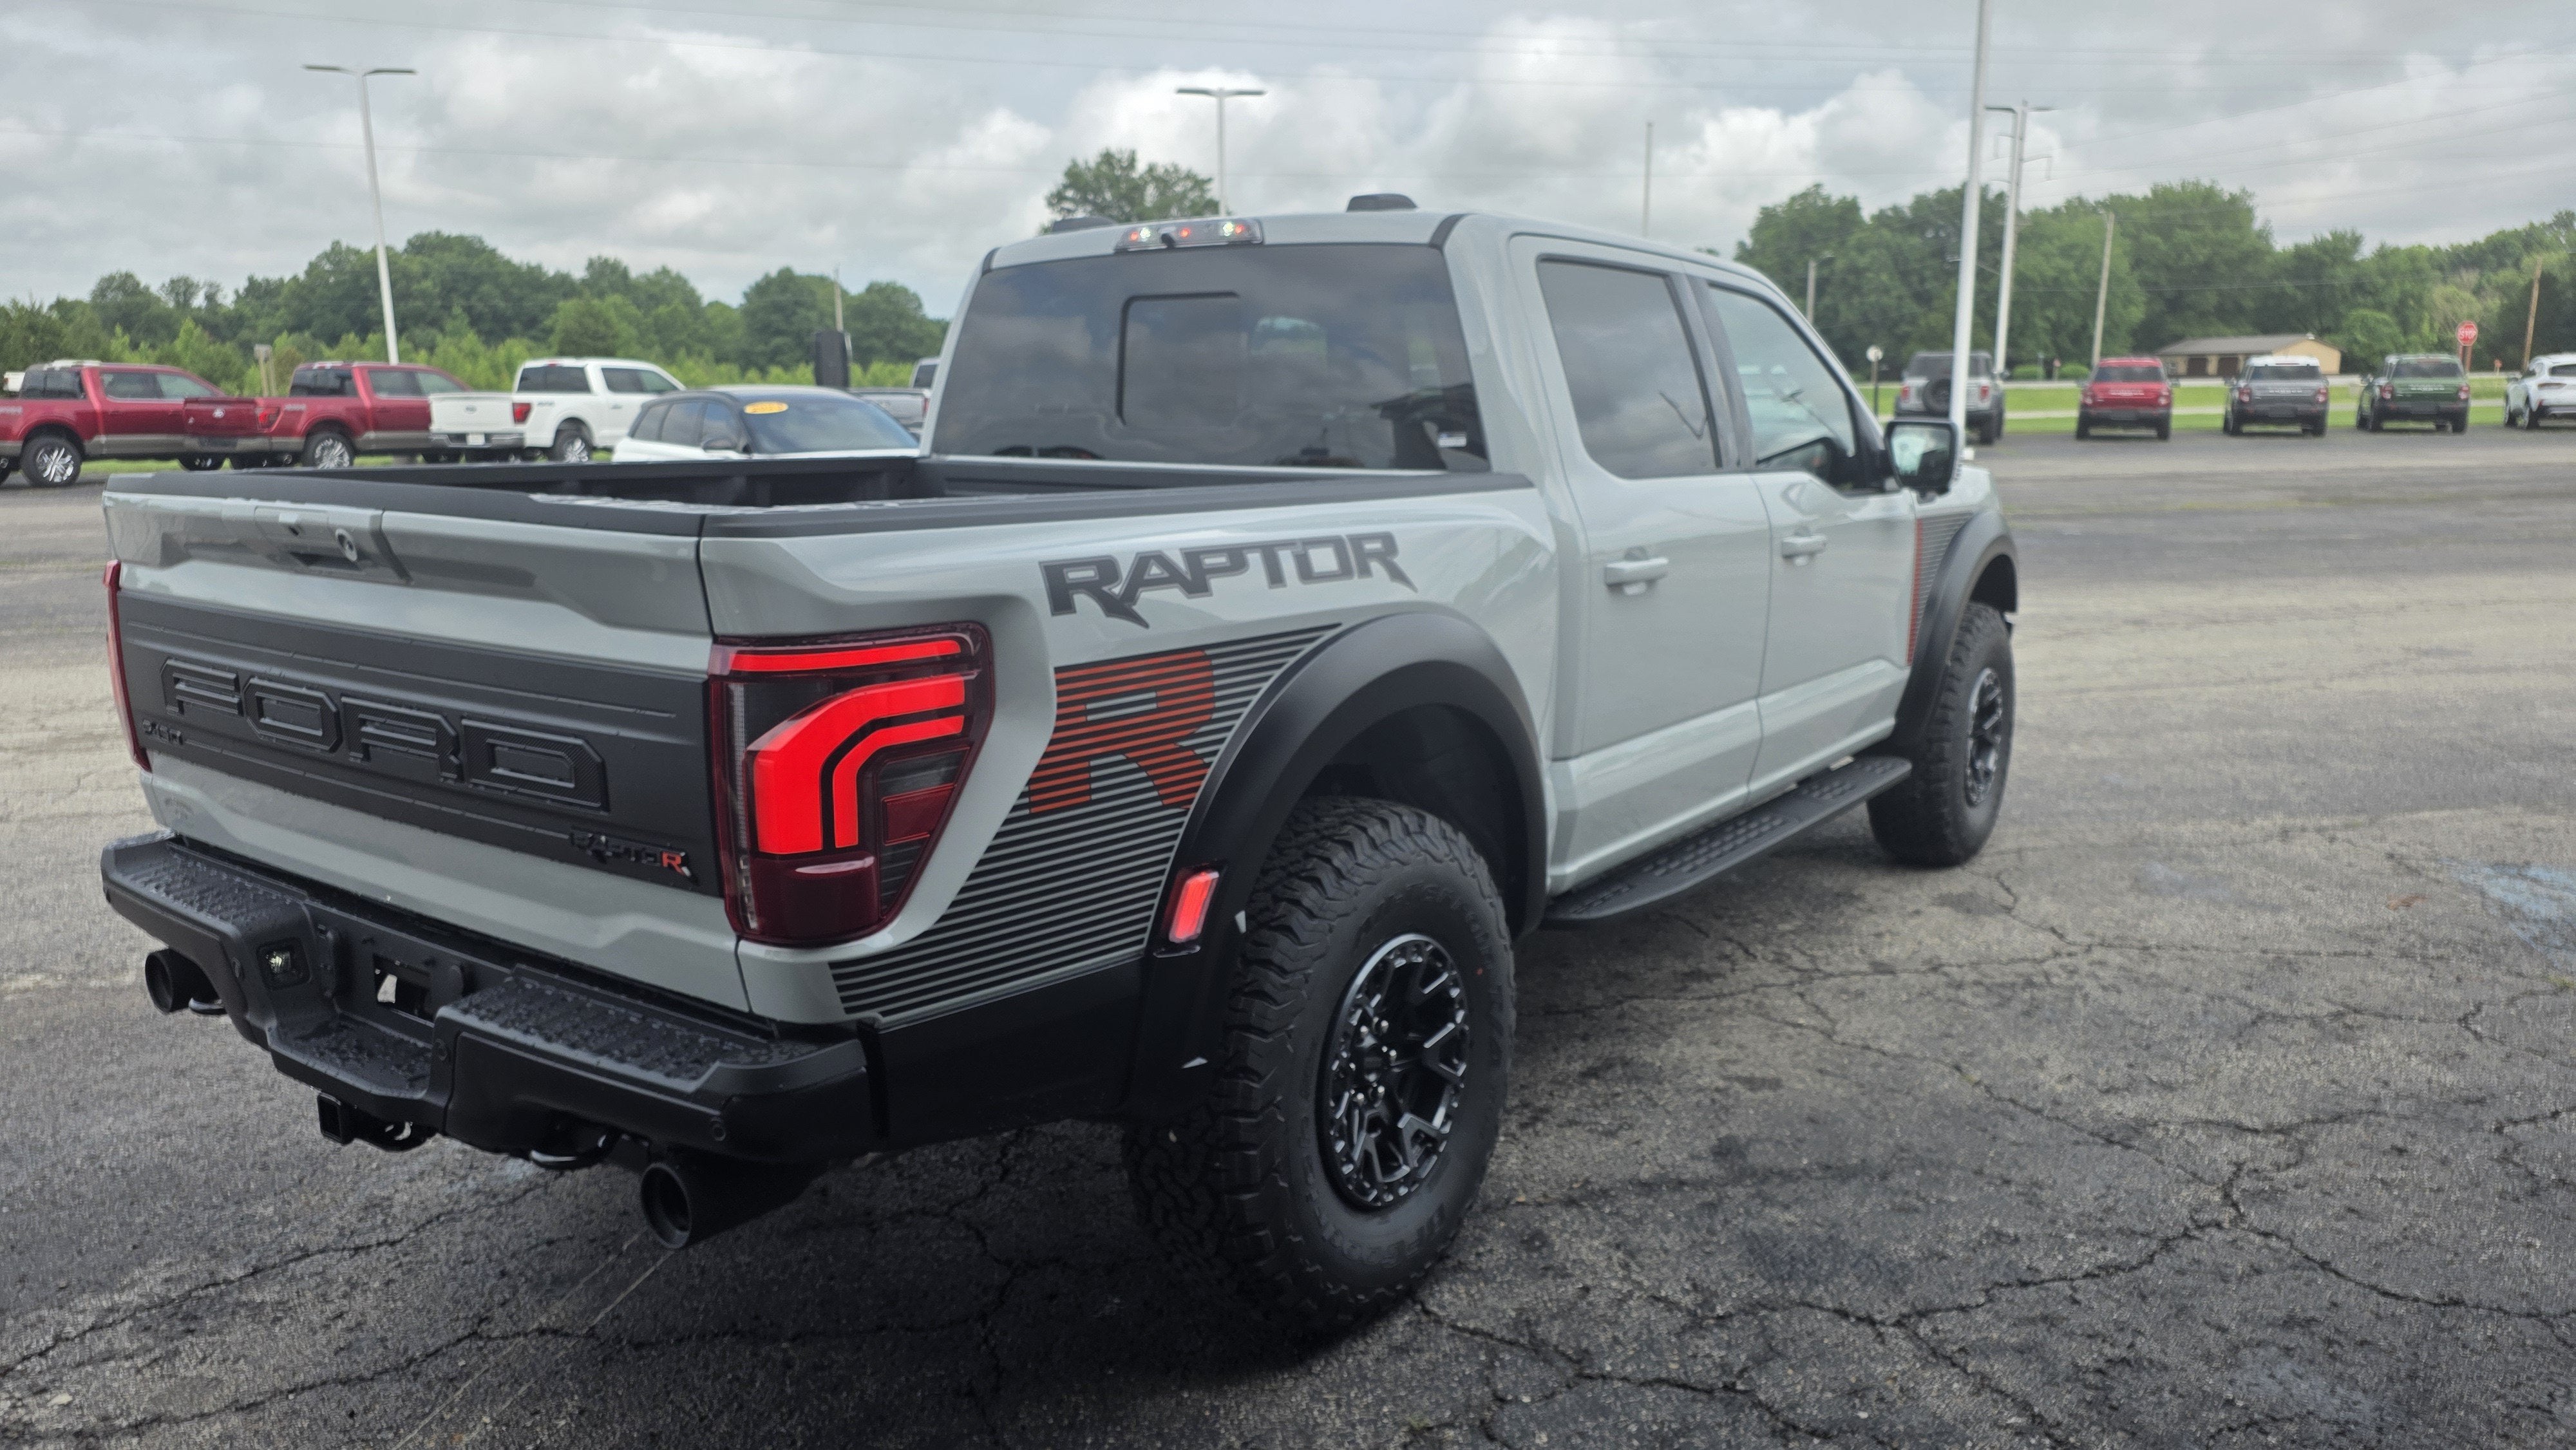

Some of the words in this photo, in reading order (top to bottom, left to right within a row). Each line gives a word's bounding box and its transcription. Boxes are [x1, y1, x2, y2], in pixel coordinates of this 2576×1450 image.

[2459, 327, 2477, 339] STOP
[1039, 532, 1418, 629] RAPTOR
[159, 657, 609, 813] FORD
